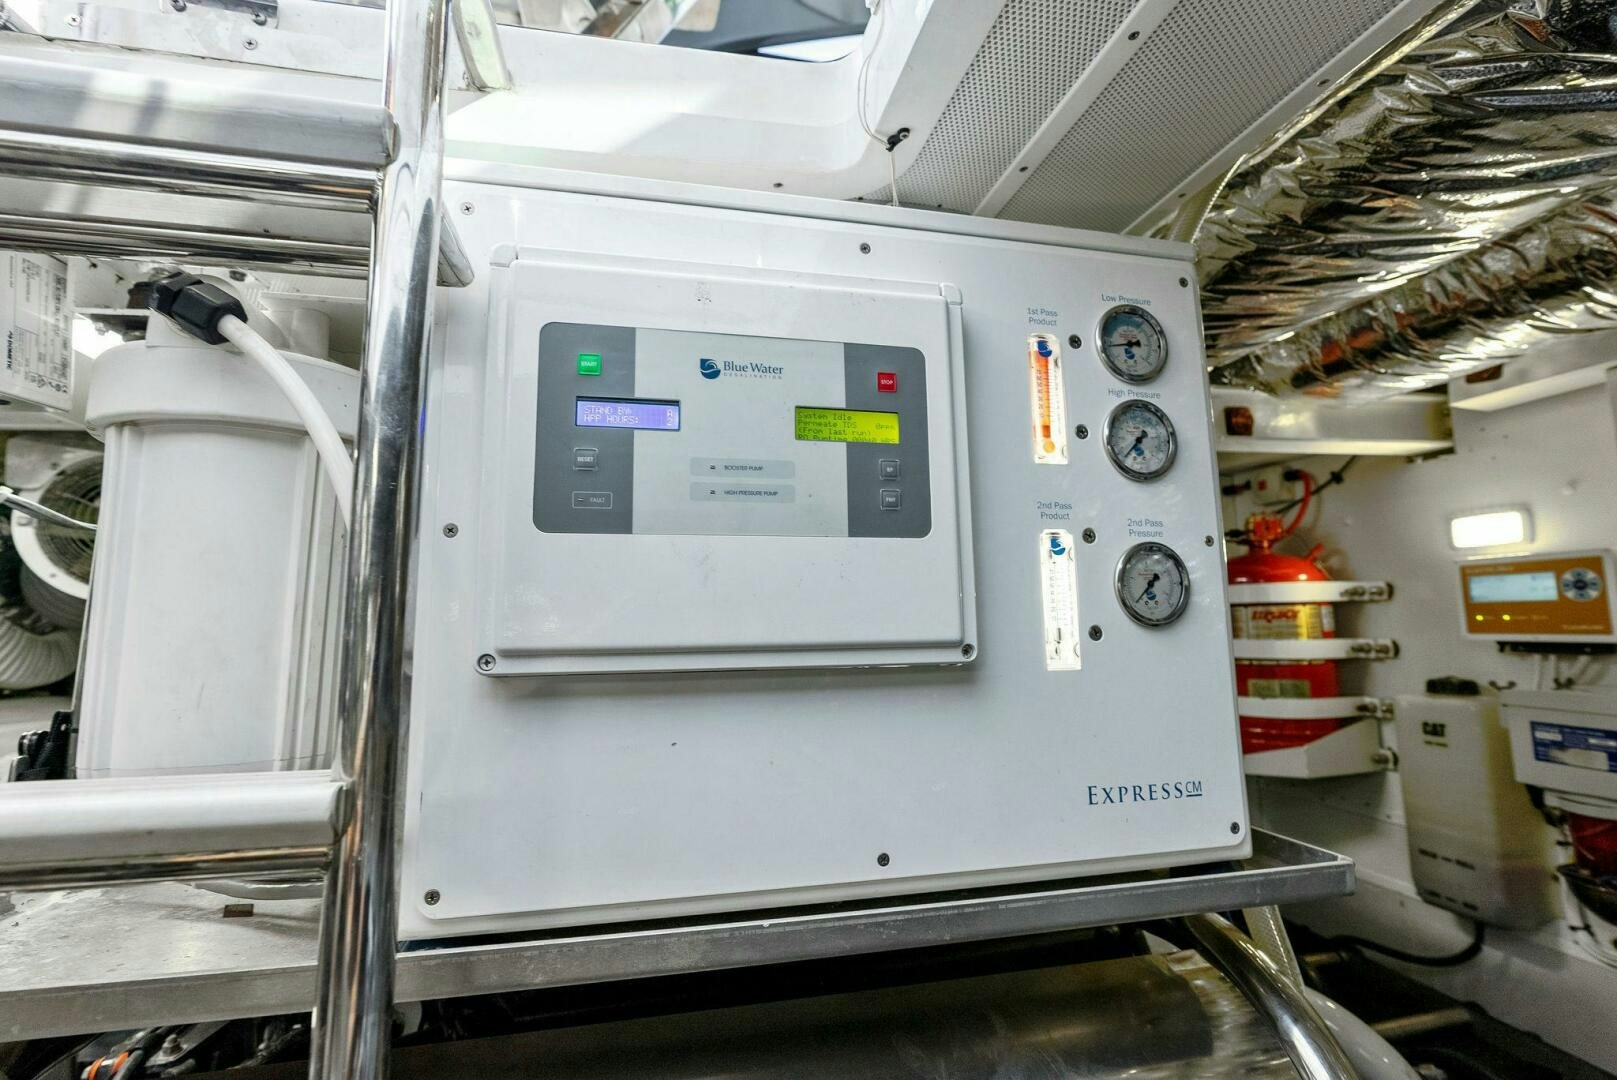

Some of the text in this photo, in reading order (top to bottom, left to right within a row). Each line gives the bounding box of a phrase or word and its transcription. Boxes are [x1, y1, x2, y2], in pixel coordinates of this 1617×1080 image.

[1101, 293, 1151, 305] Low Pressure
[1027, 308, 1058, 317] 1st Pass
[1028, 317, 1057, 326] Product
[723, 360, 784, 375] Blue Water
[1107, 388, 1161, 400] High Pressure
[1037, 501, 1073, 510] 2nd Pass
[1040, 512, 1070, 521] Product
[1127, 518, 1164, 528] 2nd Pass
[1128, 529, 1164, 538] Pressure
[1422, 721, 1446, 738] CAT
